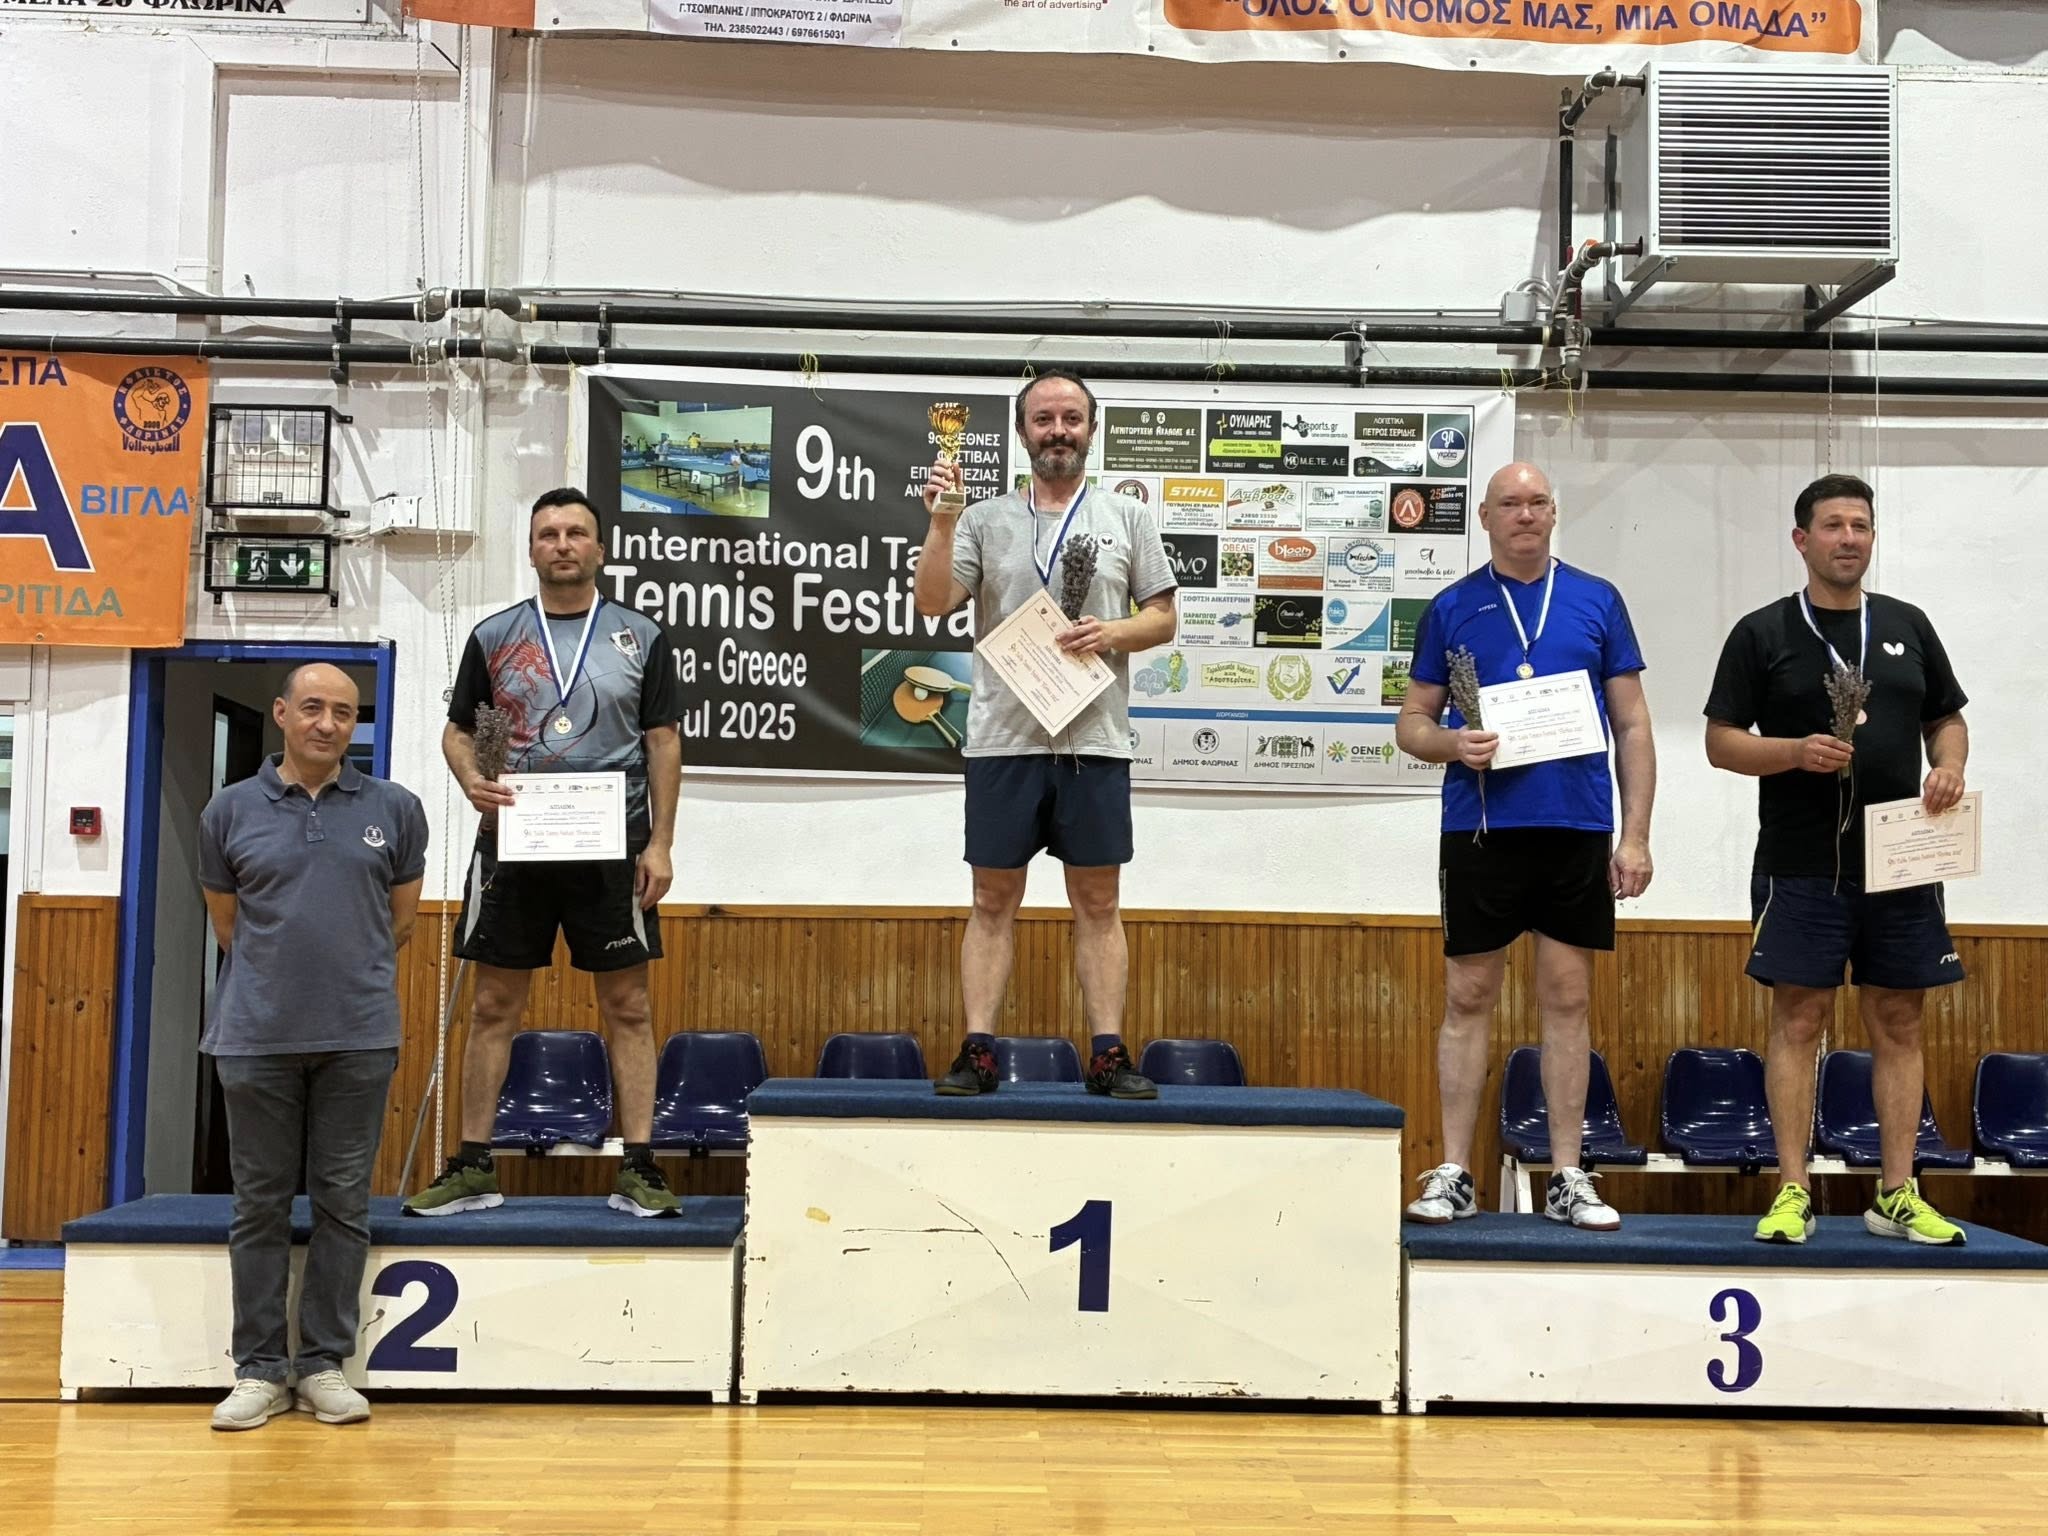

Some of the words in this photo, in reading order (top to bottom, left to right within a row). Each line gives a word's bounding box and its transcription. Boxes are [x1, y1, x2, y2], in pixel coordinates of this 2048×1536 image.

[1022, 0, 1036, 8] art
[1037, 0, 1047, 8] of
[817, 13, 823, 21] 2
[829, 13, 872, 24] ΦΛΩΡΙΝΑ
[1385, 0, 1512, 24] ΝΟΜΟΣ
[1522, 3, 1604, 34] ΜΑΣ,
[1615, 5, 1678, 31] ΜΙΑ
[704, 22, 726, 33] ΤΗΛ.
[728, 24, 784, 36] 2385022443
[791, 28, 845, 40] 6976615031
[1229, 414, 1273, 429] ΟΥΛΙΑΡΗΣ
[1373, 417, 1405, 425] ΛΟΓΙΣΤΙΚΑ
[1362, 427, 1388, 437] ΠΕΤΡΟΣ
[1389, 428, 1416, 438] ΣΕΡΙΔΗΣ
[122, 432, 180, 455] Volleyball
[796, 424, 876, 502] 9th
[937, 450, 1001, 465] ΦΣΤΙΒΑΛ
[80, 484, 190, 516] ΒΙΓΛΑ
[1168, 486, 1220, 498] STIHL
[1429, 488, 1442, 501] 25
[611, 525, 869, 571] International
[1222, 543, 1256, 552] ΟΒΕΛΙΞ
[1274, 541, 1312, 559] bloom
[603, 565, 777, 632] Tennis
[1210, 596, 1251, 604] ΑΙΚΑΤΕΡΙΝΗ
[718, 637, 808, 688] Greece
[1334, 656, 1367, 665] ΛΟΓΙΣΤΙΚΑ
[1391, 660, 1411, 670] ΚΡΕ
[719, 701, 797, 741] 2025
[1172, 759, 1199, 767] ΔΗΜΟΣ
[1200, 759, 1239, 767] ΦΛΩΡΙΝΑΣ
[1253, 761, 1280, 769] ΔΗΜΟΣ
[1280, 762, 1315, 770] ΠΡΕΣΠΩΝ
[1049, 1200, 1113, 1313] 1
[366, 1259, 459, 1373] 2
[1706, 1287, 1763, 1393] 3
